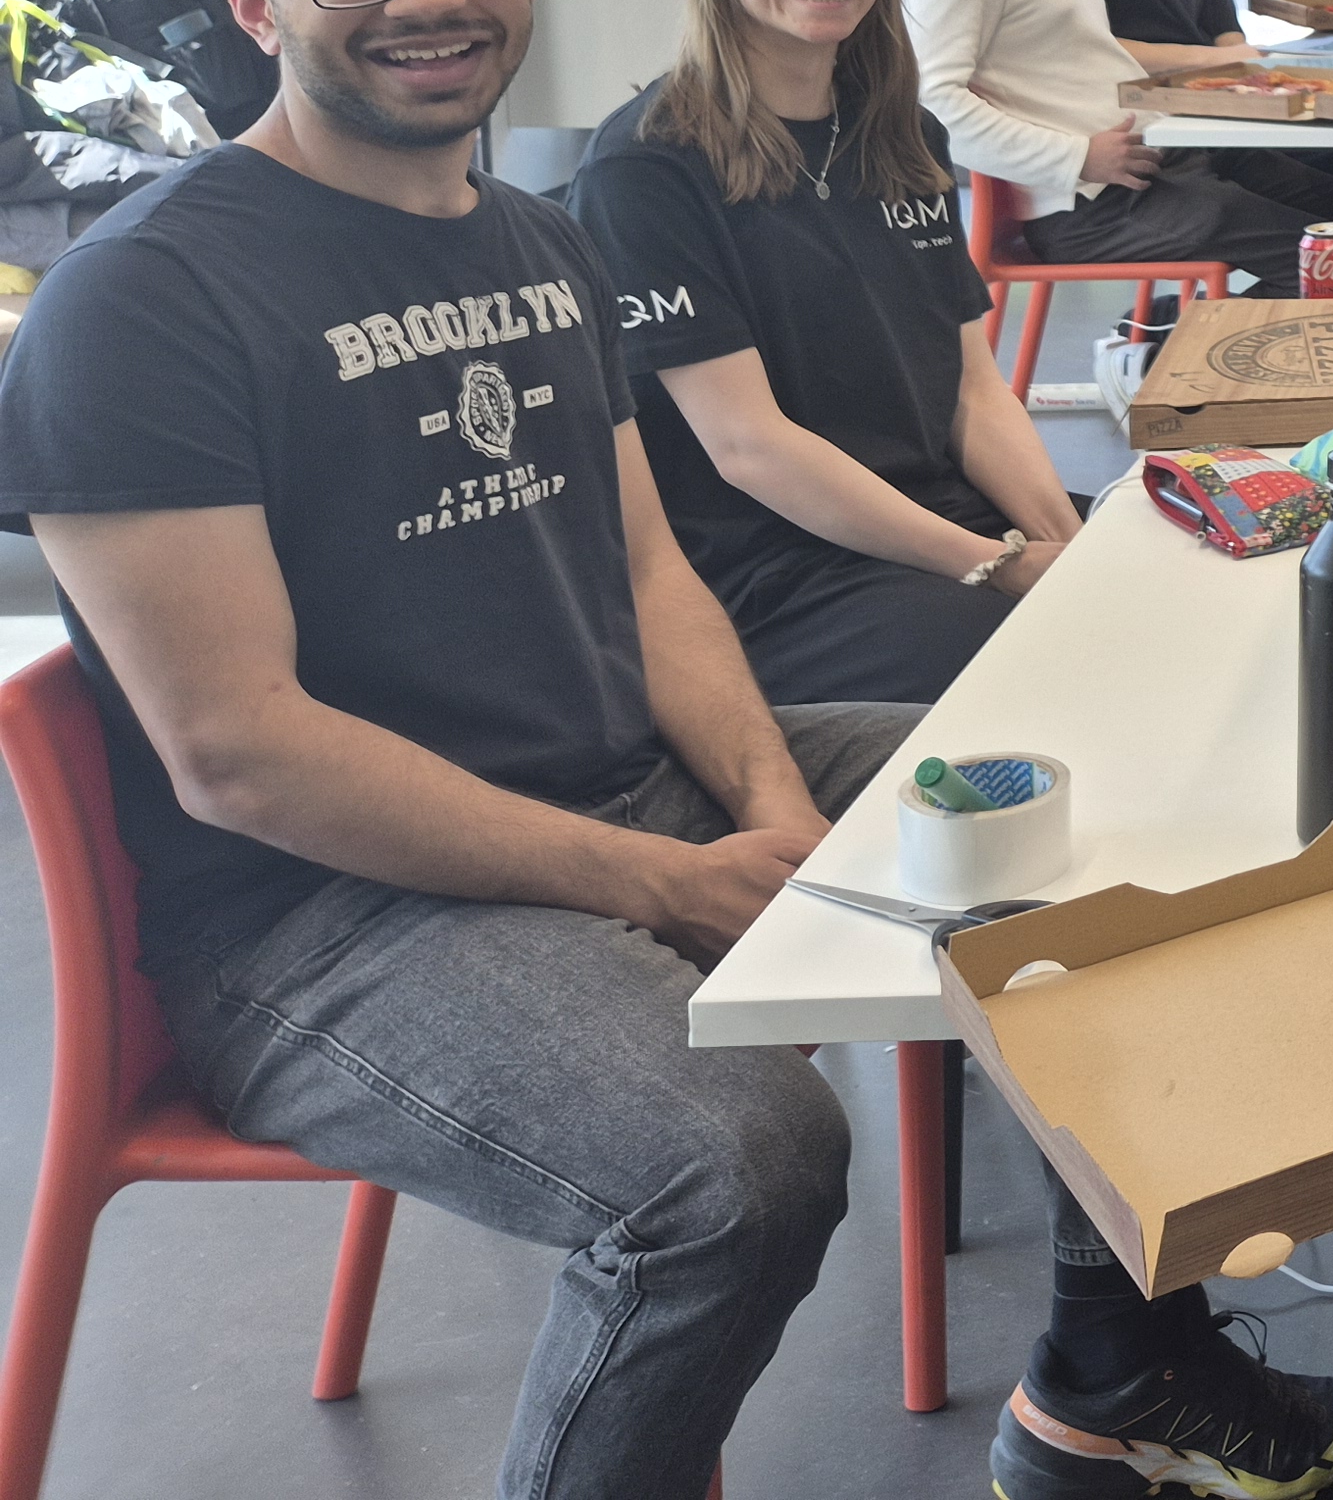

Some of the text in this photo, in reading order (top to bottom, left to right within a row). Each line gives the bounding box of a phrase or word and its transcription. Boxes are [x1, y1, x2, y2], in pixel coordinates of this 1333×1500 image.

[881, 193, 950, 230] IQM
[616, 284, 697, 329] QM
[324, 279, 583, 382] BROOKLYN
[529, 388, 552, 404] NYC
[427, 416, 448, 432] USA
